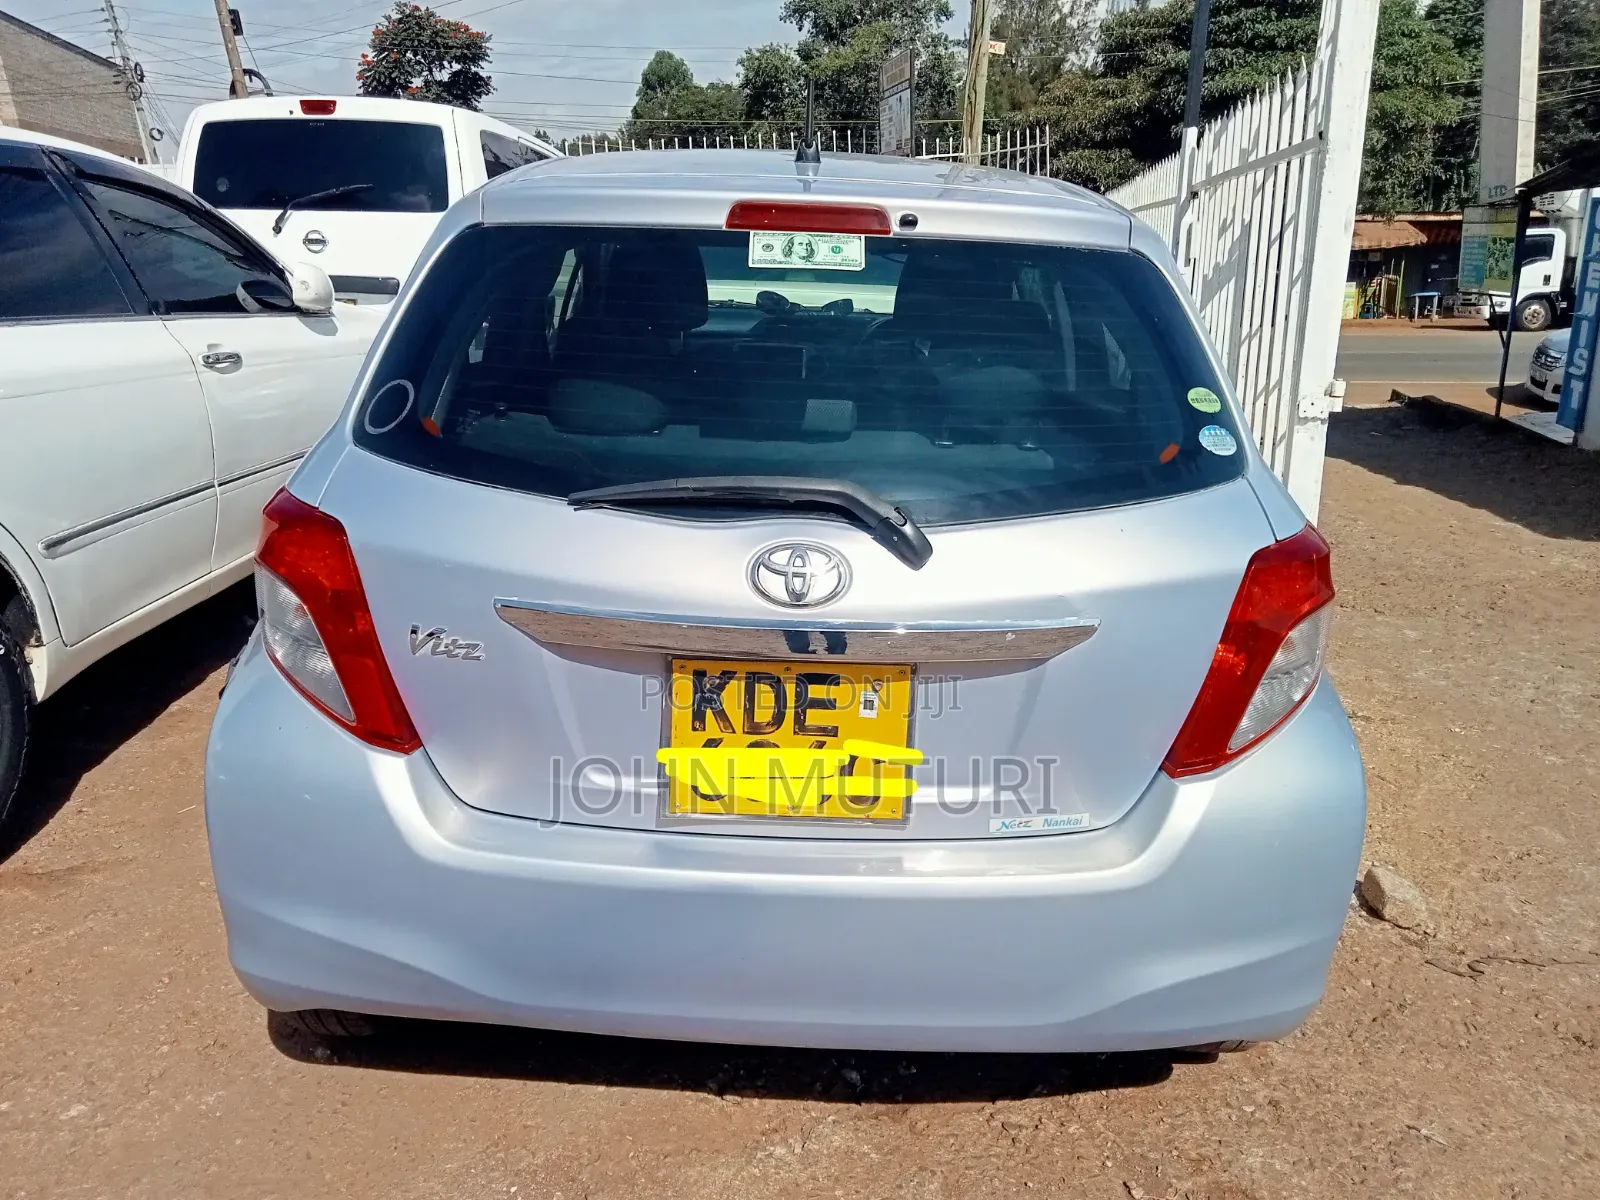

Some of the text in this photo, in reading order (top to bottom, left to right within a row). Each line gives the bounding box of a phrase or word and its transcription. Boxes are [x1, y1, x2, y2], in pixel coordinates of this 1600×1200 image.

[408, 623, 485, 661] Vitz
[691, 668, 841, 738] KDE
[995, 816, 1084, 831] Netz Nankai
